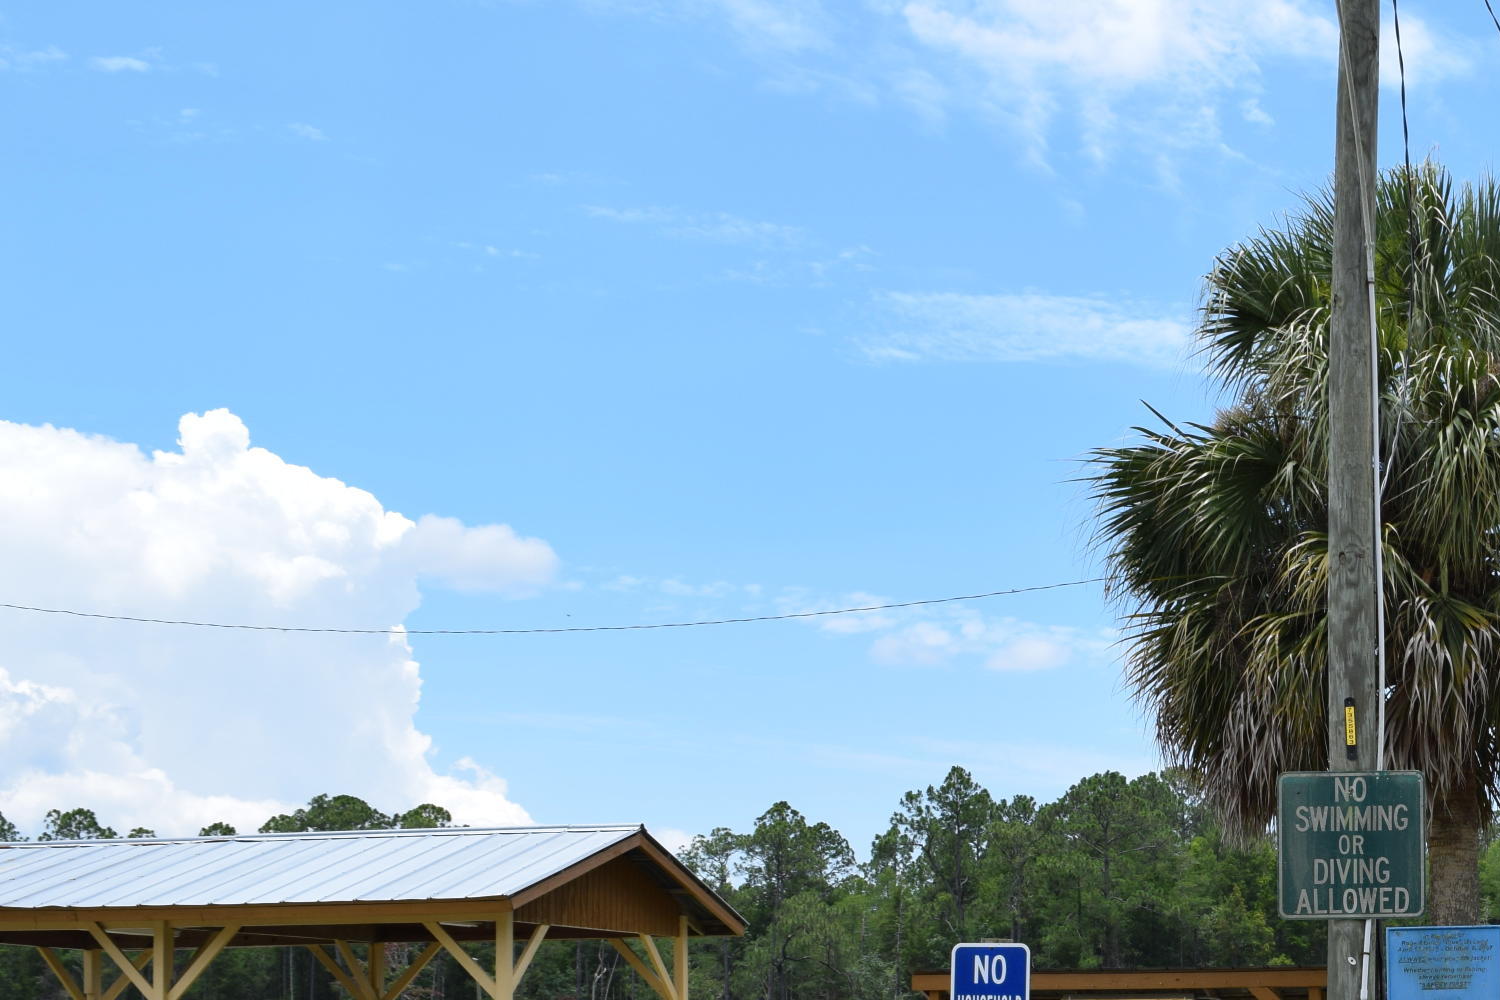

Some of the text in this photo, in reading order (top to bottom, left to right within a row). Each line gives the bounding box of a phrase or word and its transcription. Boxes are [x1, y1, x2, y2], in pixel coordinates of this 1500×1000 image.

[1334, 777, 1367, 802] NO
[1295, 804, 1409, 832] SWIMMING
[1338, 834, 1364, 855] OR
[1313, 857, 1390, 885] DIVING
[1296, 887, 1410, 915] ALLOWED
[973, 955, 1007, 985] NO
